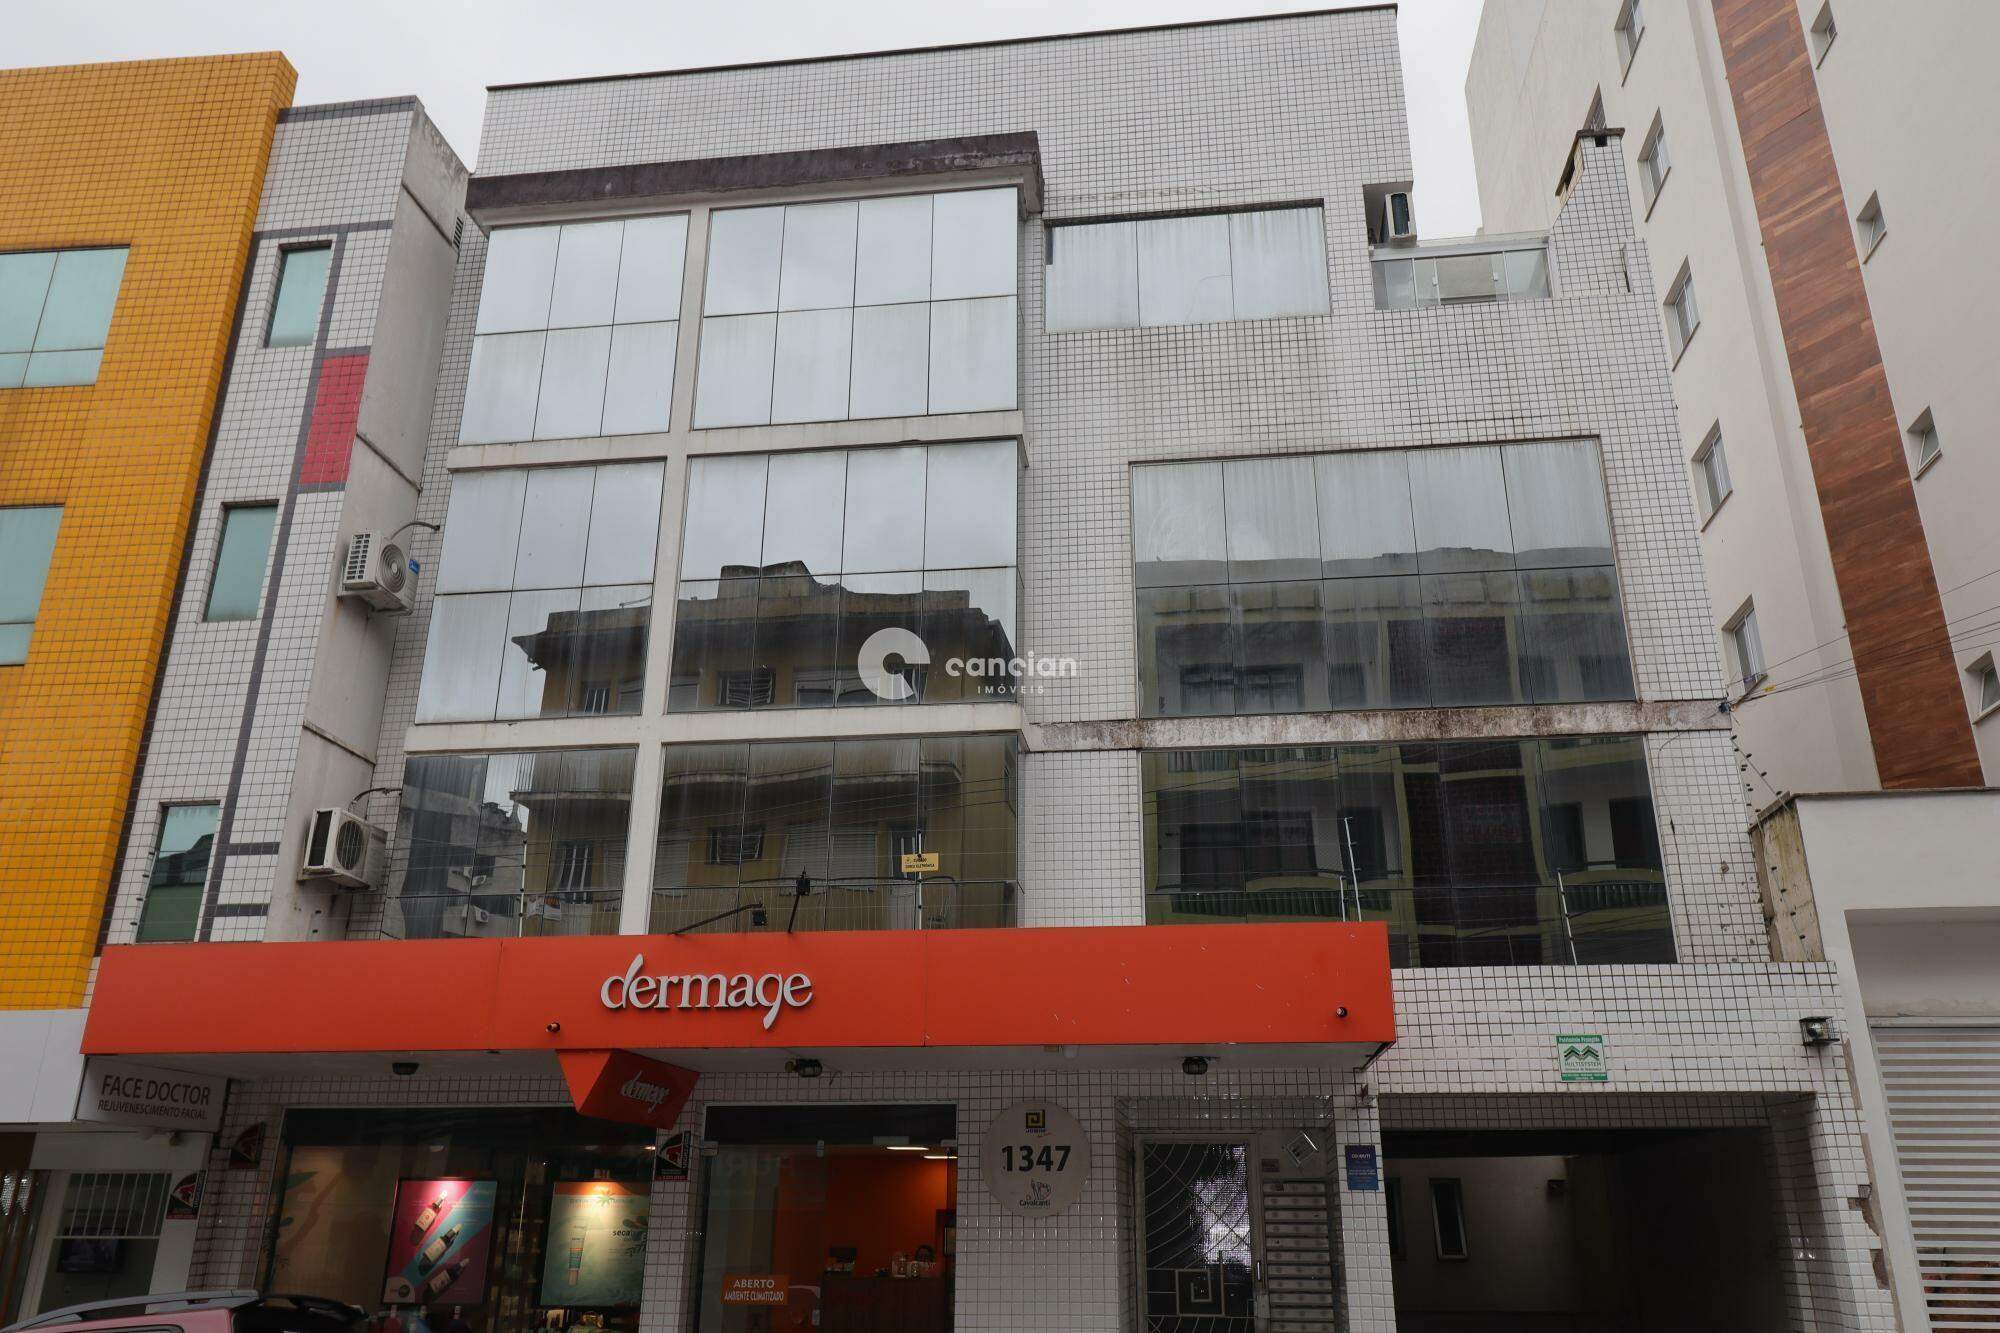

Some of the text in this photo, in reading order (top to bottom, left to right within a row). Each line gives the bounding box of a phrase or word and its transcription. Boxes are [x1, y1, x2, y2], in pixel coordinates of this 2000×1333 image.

[600, 953, 814, 1030] dermage
[101, 1074, 211, 1106] FACE DOCTOR
[97, 1099, 208, 1120] REJUVENESCIMENTO FACIAL
[1001, 1145, 1072, 1172] 1347
[733, 1279, 775, 1289] ABERTO
